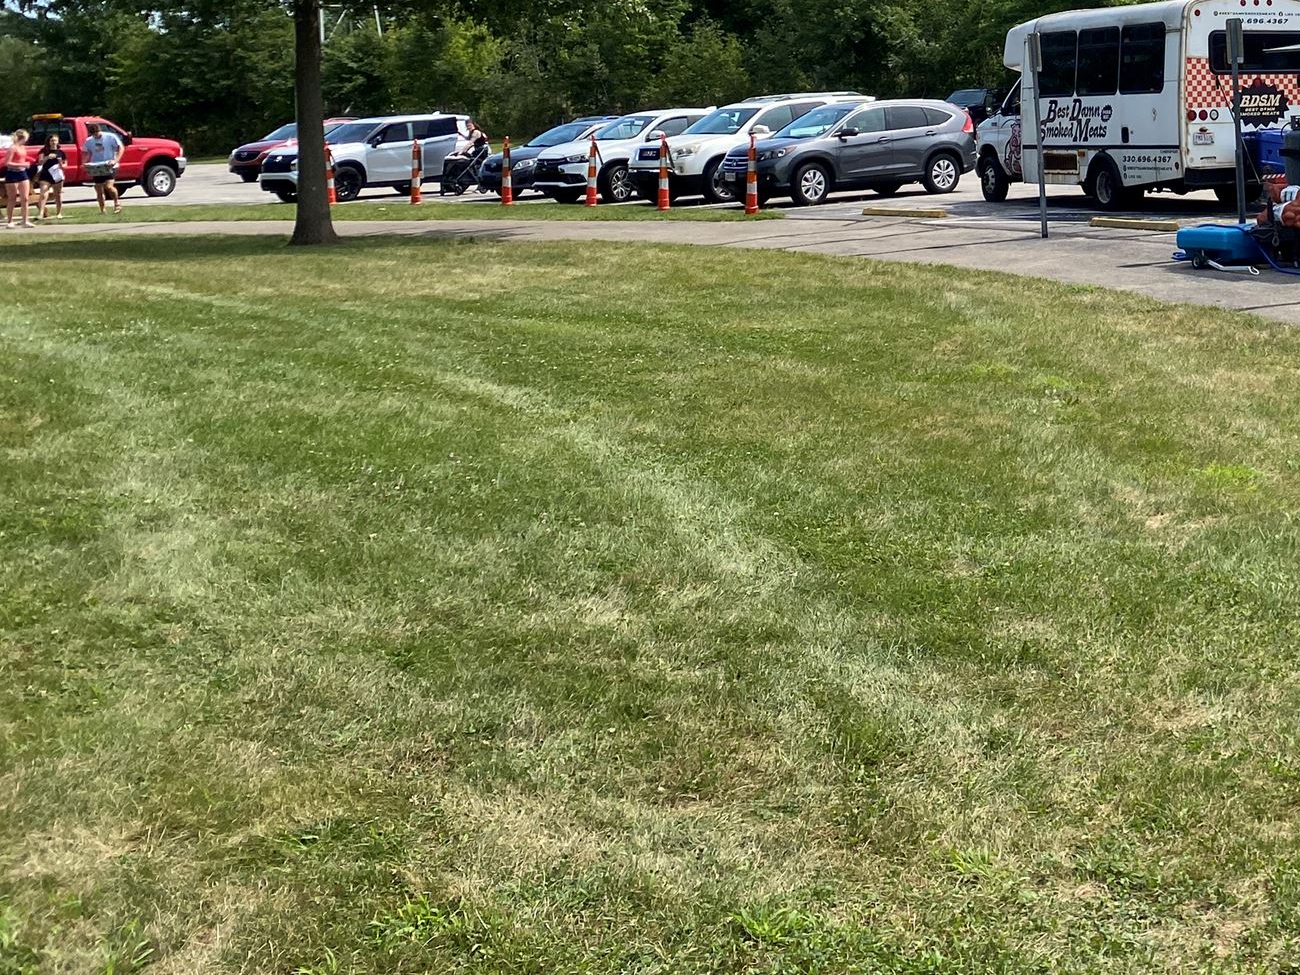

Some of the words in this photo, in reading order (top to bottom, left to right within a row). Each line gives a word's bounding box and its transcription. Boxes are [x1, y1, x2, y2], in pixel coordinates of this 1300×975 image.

[1240, 94, 1282, 107] BDSM
[1044, 100, 1070, 123] Best
[1069, 98, 1101, 121] Damn
[1072, 118, 1107, 142] Meats
[1122, 155, 1172, 163] 330.696.4367
